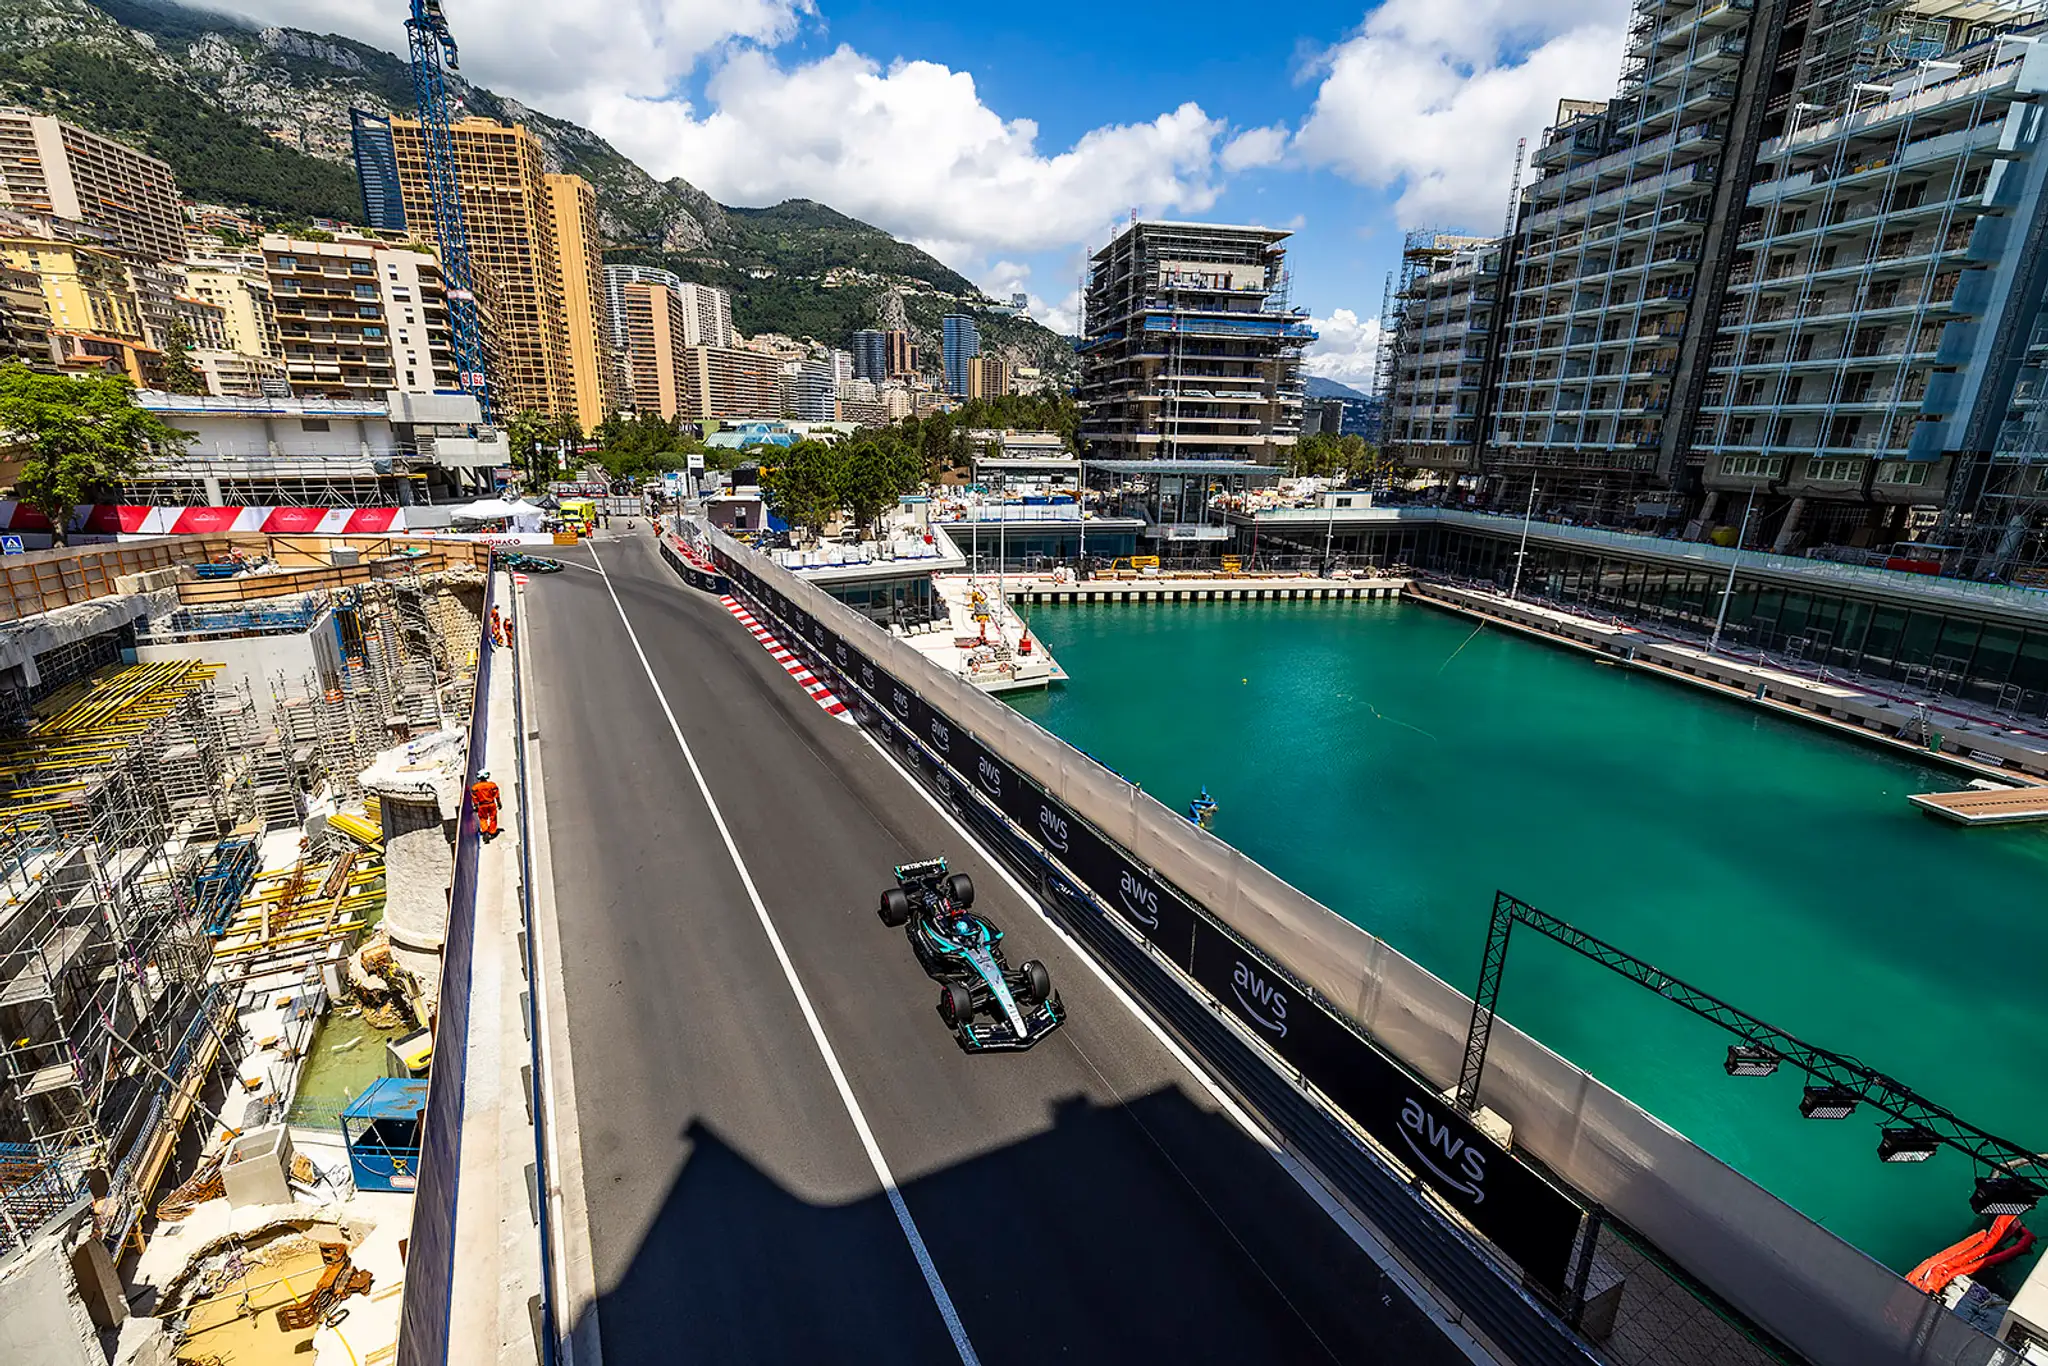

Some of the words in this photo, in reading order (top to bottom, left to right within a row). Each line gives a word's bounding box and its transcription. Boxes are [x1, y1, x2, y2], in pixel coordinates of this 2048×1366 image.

[893, 688, 908, 709] aws
[931, 718, 949, 742] aws
[979, 756, 1000, 785] aws
[1040, 805, 1068, 839] aws
[1121, 870, 1159, 914] aws
[1233, 961, 1288, 1019] aws
[1401, 1097, 1486, 1182] aws
